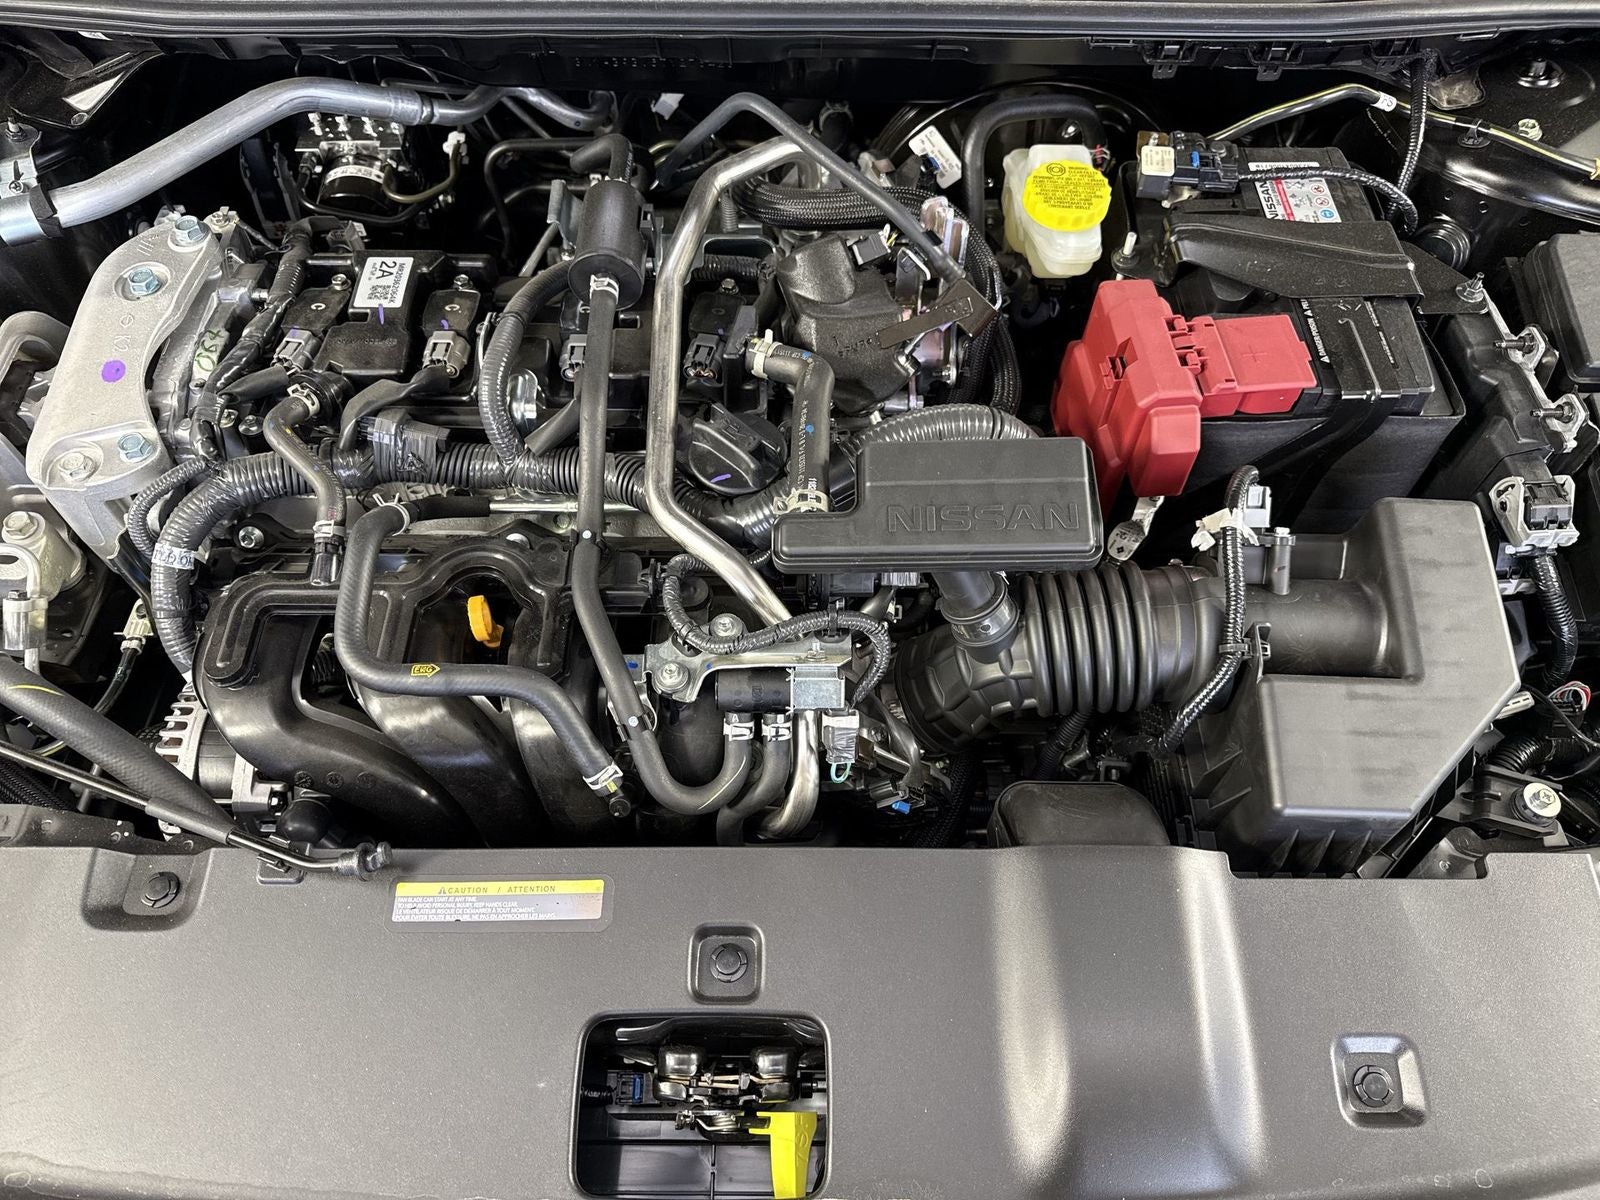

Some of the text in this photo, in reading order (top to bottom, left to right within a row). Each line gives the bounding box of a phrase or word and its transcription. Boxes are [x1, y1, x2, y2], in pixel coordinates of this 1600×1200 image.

[375, 260, 397, 280] 2A
[886, 502, 1081, 533] NISSAN
[447, 886, 488, 894] CAUTION
[507, 885, 556, 893] ATTENTION
